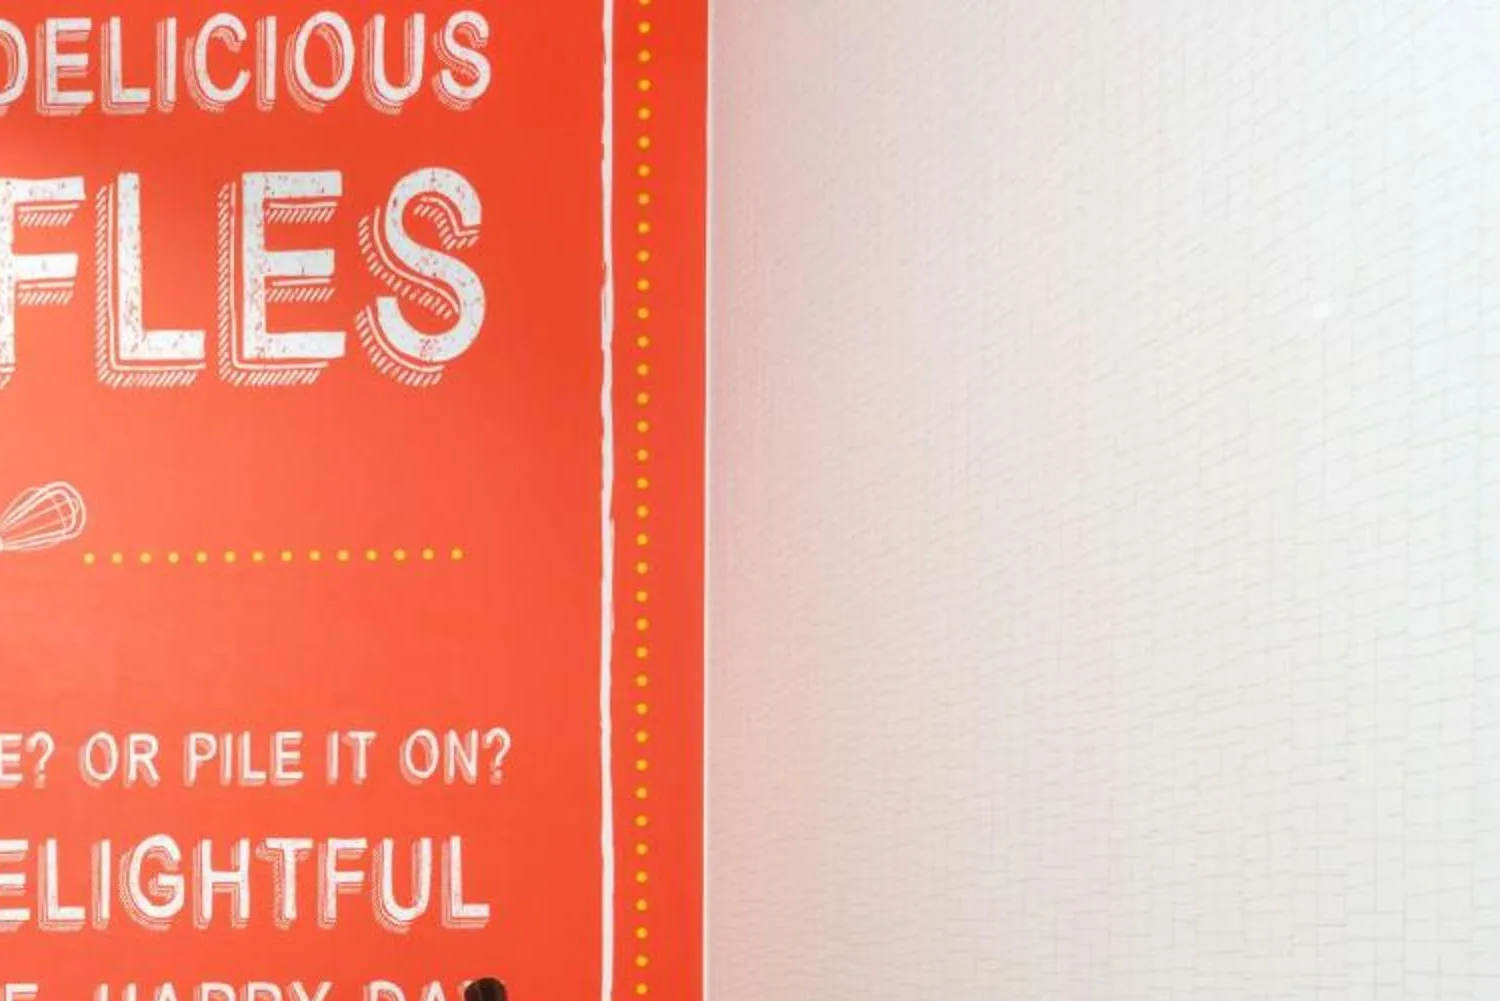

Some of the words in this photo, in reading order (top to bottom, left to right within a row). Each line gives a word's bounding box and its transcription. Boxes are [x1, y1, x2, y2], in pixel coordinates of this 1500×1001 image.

[80, 731, 161, 786] OR
[183, 731, 303, 785] PILE
[326, 731, 376, 785] IT
[399, 728, 511, 785] ON?
